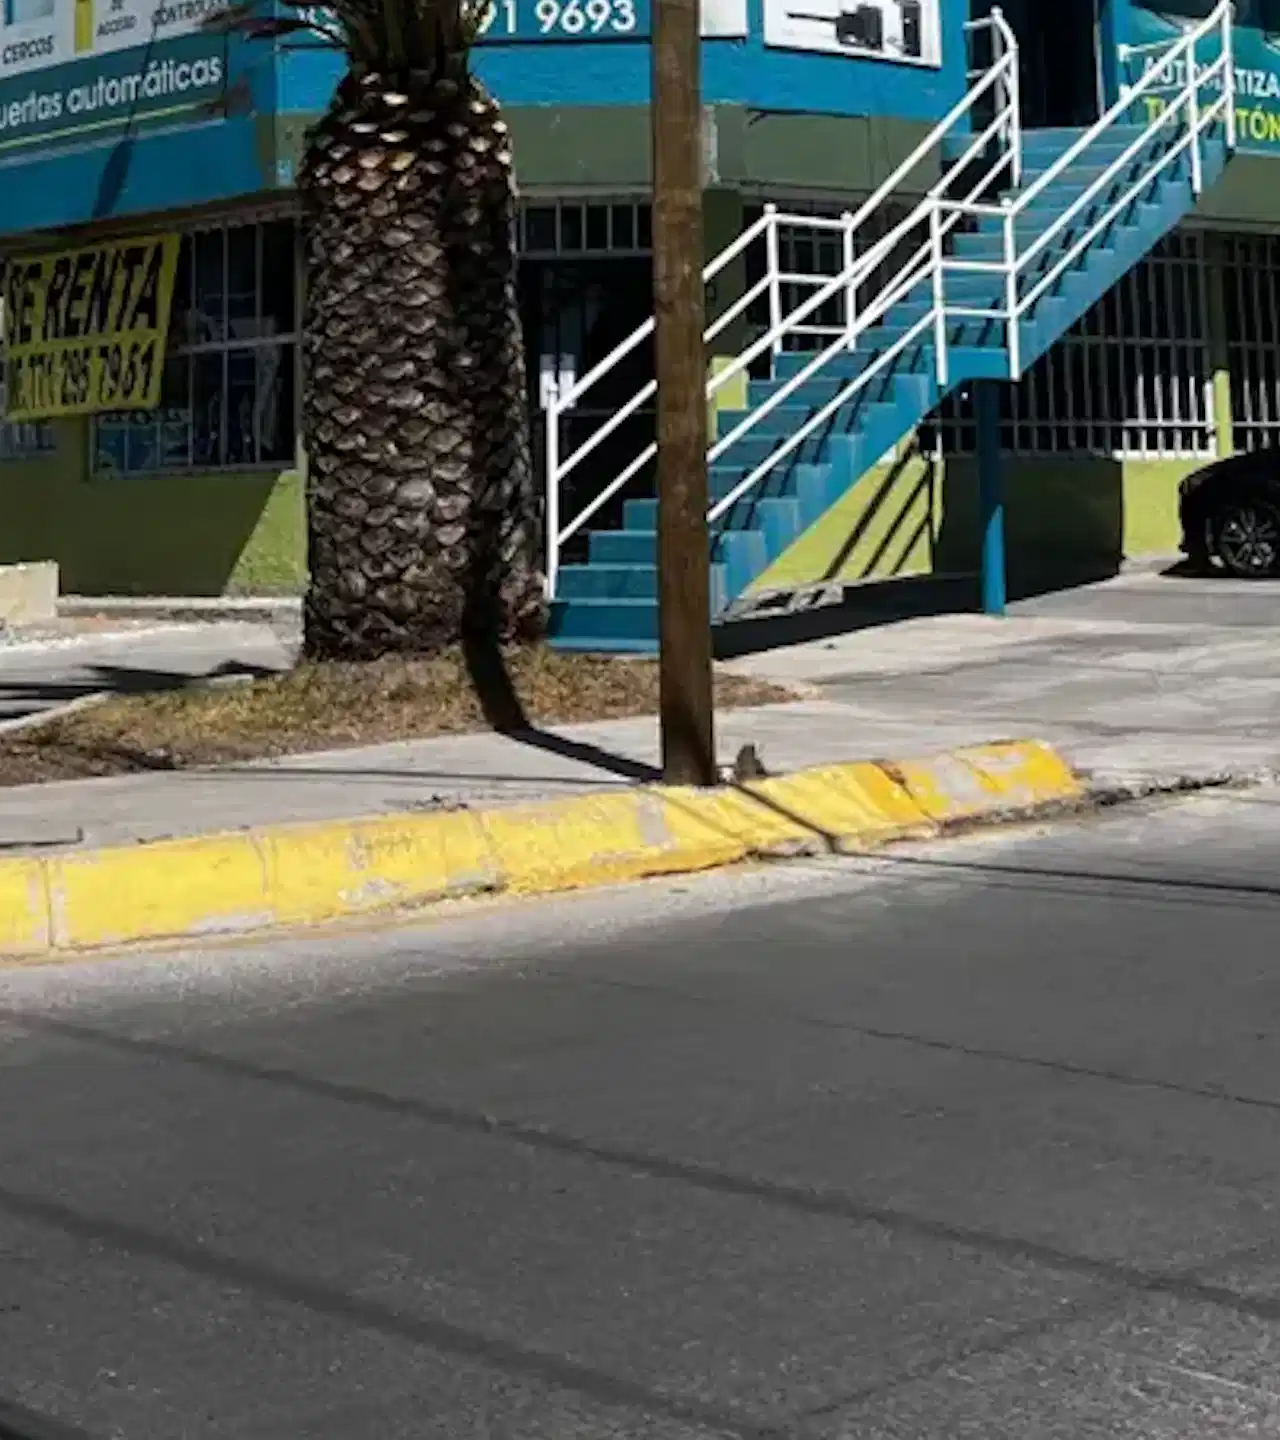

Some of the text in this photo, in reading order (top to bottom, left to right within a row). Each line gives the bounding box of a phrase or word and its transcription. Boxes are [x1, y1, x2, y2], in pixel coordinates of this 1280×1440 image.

[2, 34, 55, 67] CERCOS
[70, 53, 223, 116] automáticas
[42, 242, 164, 342] RENTA
